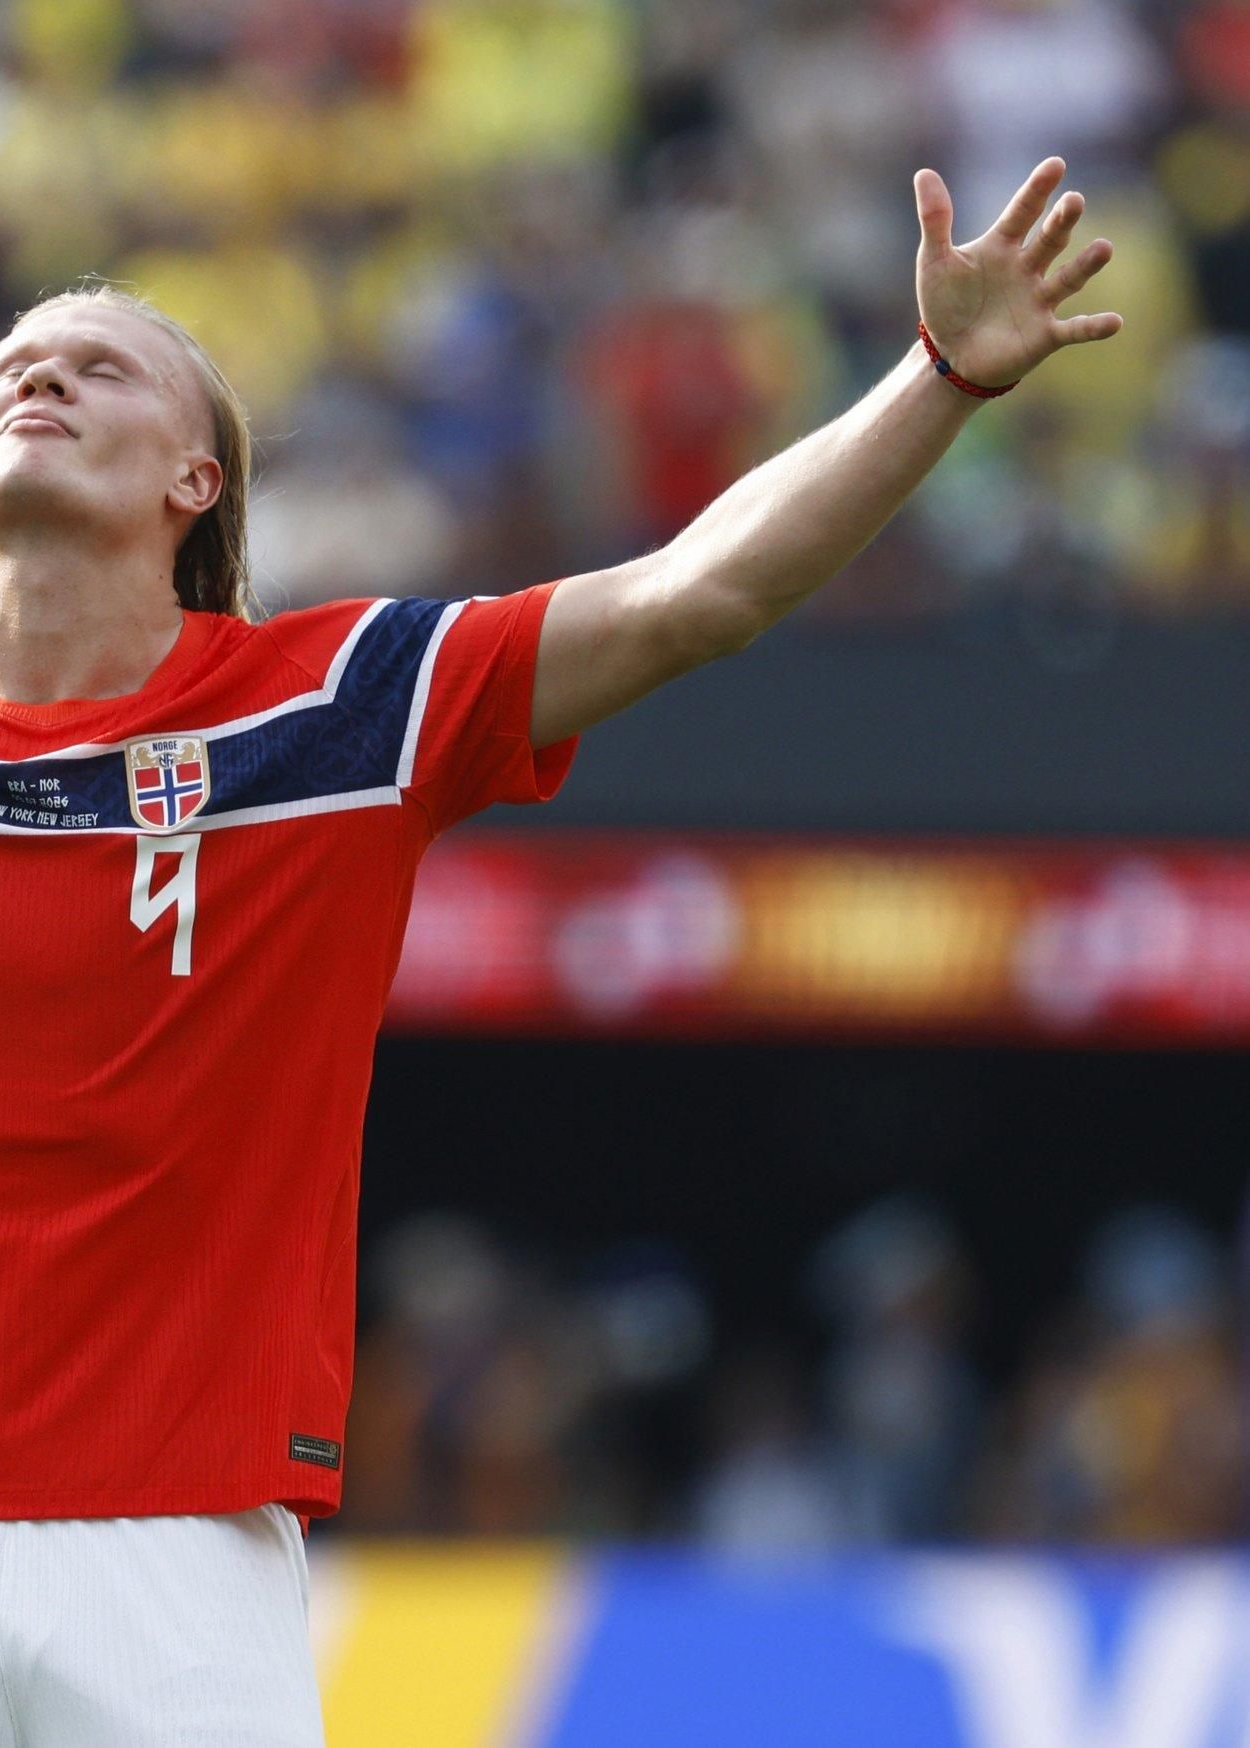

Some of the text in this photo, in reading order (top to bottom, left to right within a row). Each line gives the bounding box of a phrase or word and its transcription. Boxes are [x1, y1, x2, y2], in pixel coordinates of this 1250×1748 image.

[152, 740, 178, 752] NORGE
[7, 780, 27, 793] BRA
[39, 778, 61, 792] NOR
[10, 806, 36, 823] YORK
[37, 811, 58, 826] NEW
[60, 813, 99, 828] JERSEY
[130, 834, 202, 976] 9
